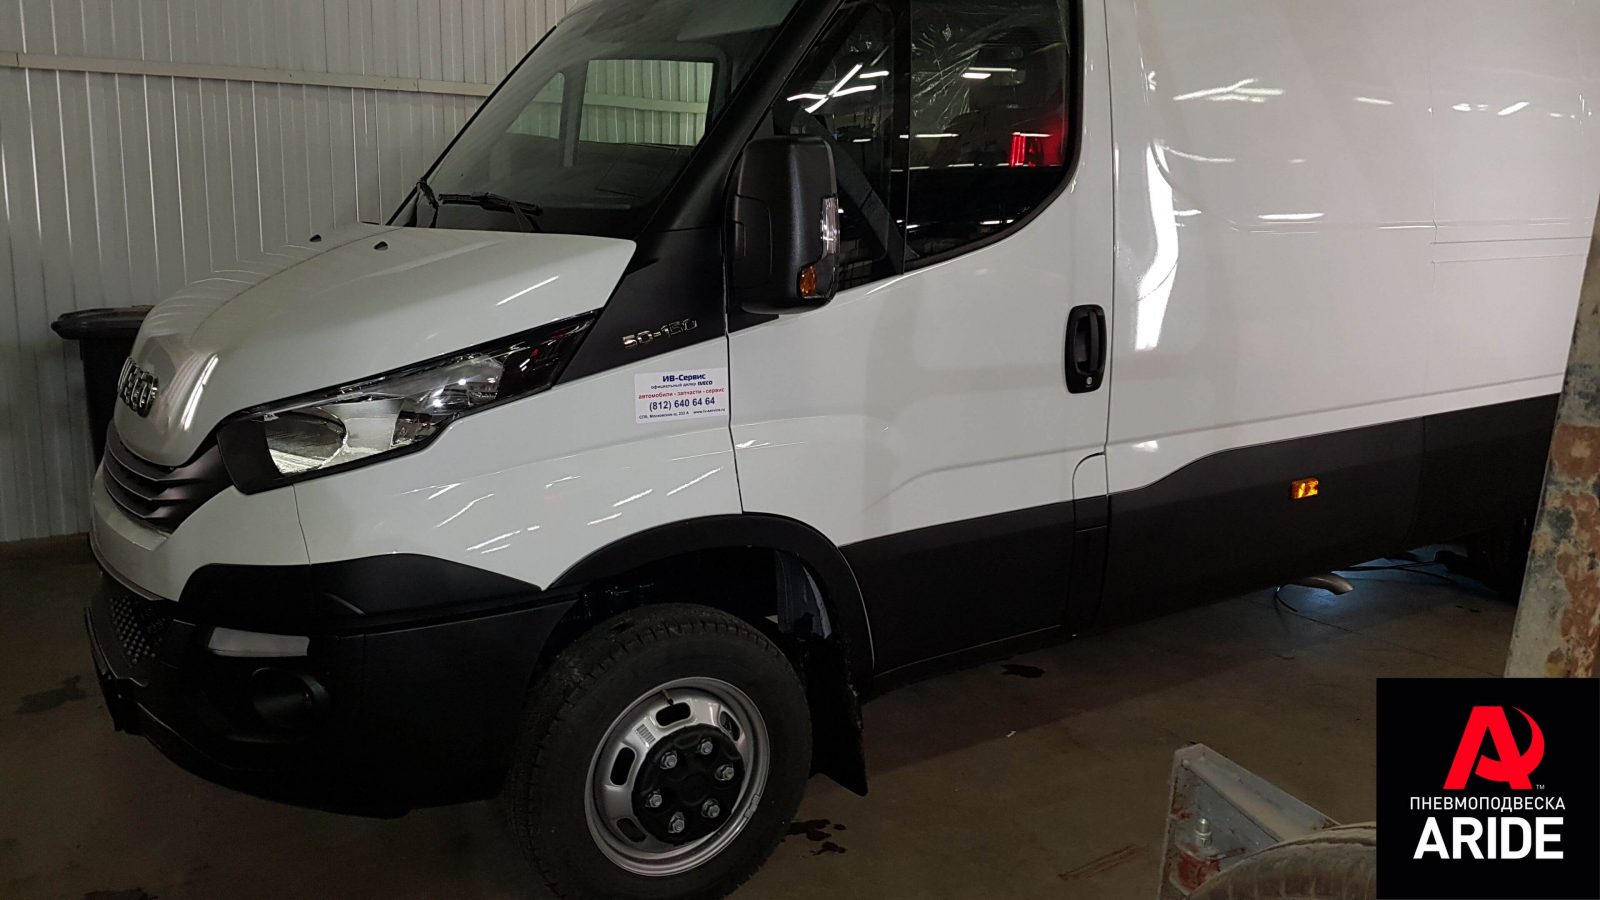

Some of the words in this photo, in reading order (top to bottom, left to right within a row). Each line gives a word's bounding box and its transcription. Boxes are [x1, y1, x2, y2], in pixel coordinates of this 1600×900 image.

[662, 373, 706, 382] ИВ-Сервис
[638, 391, 673, 399] автомобили
[649, 400, 672, 412] (812)
[674, 399, 690, 408] 640
[692, 397, 702, 406] 64
[704, 396, 715, 405] 64
